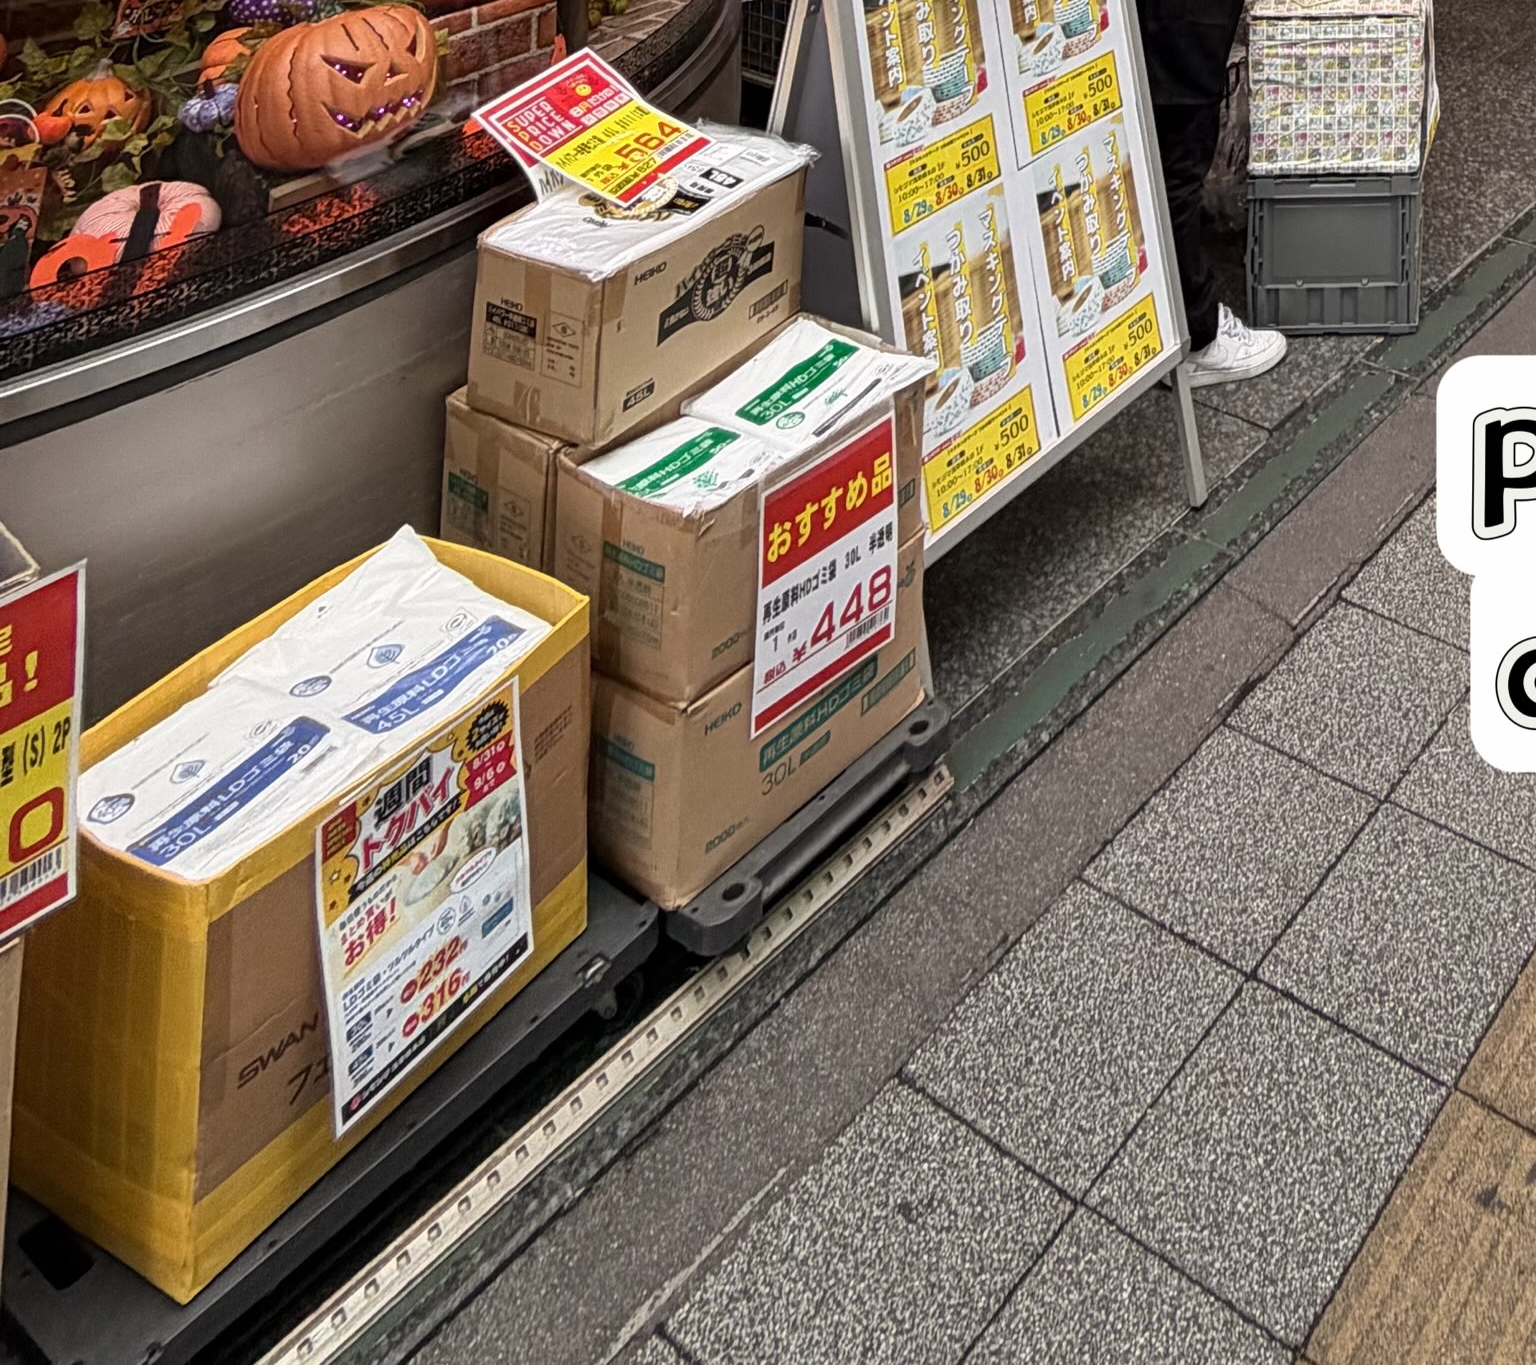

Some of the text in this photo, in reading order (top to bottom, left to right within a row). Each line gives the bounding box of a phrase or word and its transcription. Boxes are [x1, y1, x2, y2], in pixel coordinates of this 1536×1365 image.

[506, 100, 552, 133] SUPER
[518, 110, 561, 143] PRICE
[529, 119, 576, 154] DOWN
[1048, 171, 1076, 282] イベント案内
[1075, 152, 1102, 255] つかみ取り
[634, 261, 667, 286] HEIKO
[946, 229, 975, 347] つかみ取り
[767, 452, 893, 563] おすすめ品
[704, 702, 743, 736] HEIKO
[375, 756, 432, 831] 週間
[761, 757, 797, 796] 30L
[363, 766, 455, 874] トクバイ
[237, 1012, 319, 1090] SWAN
